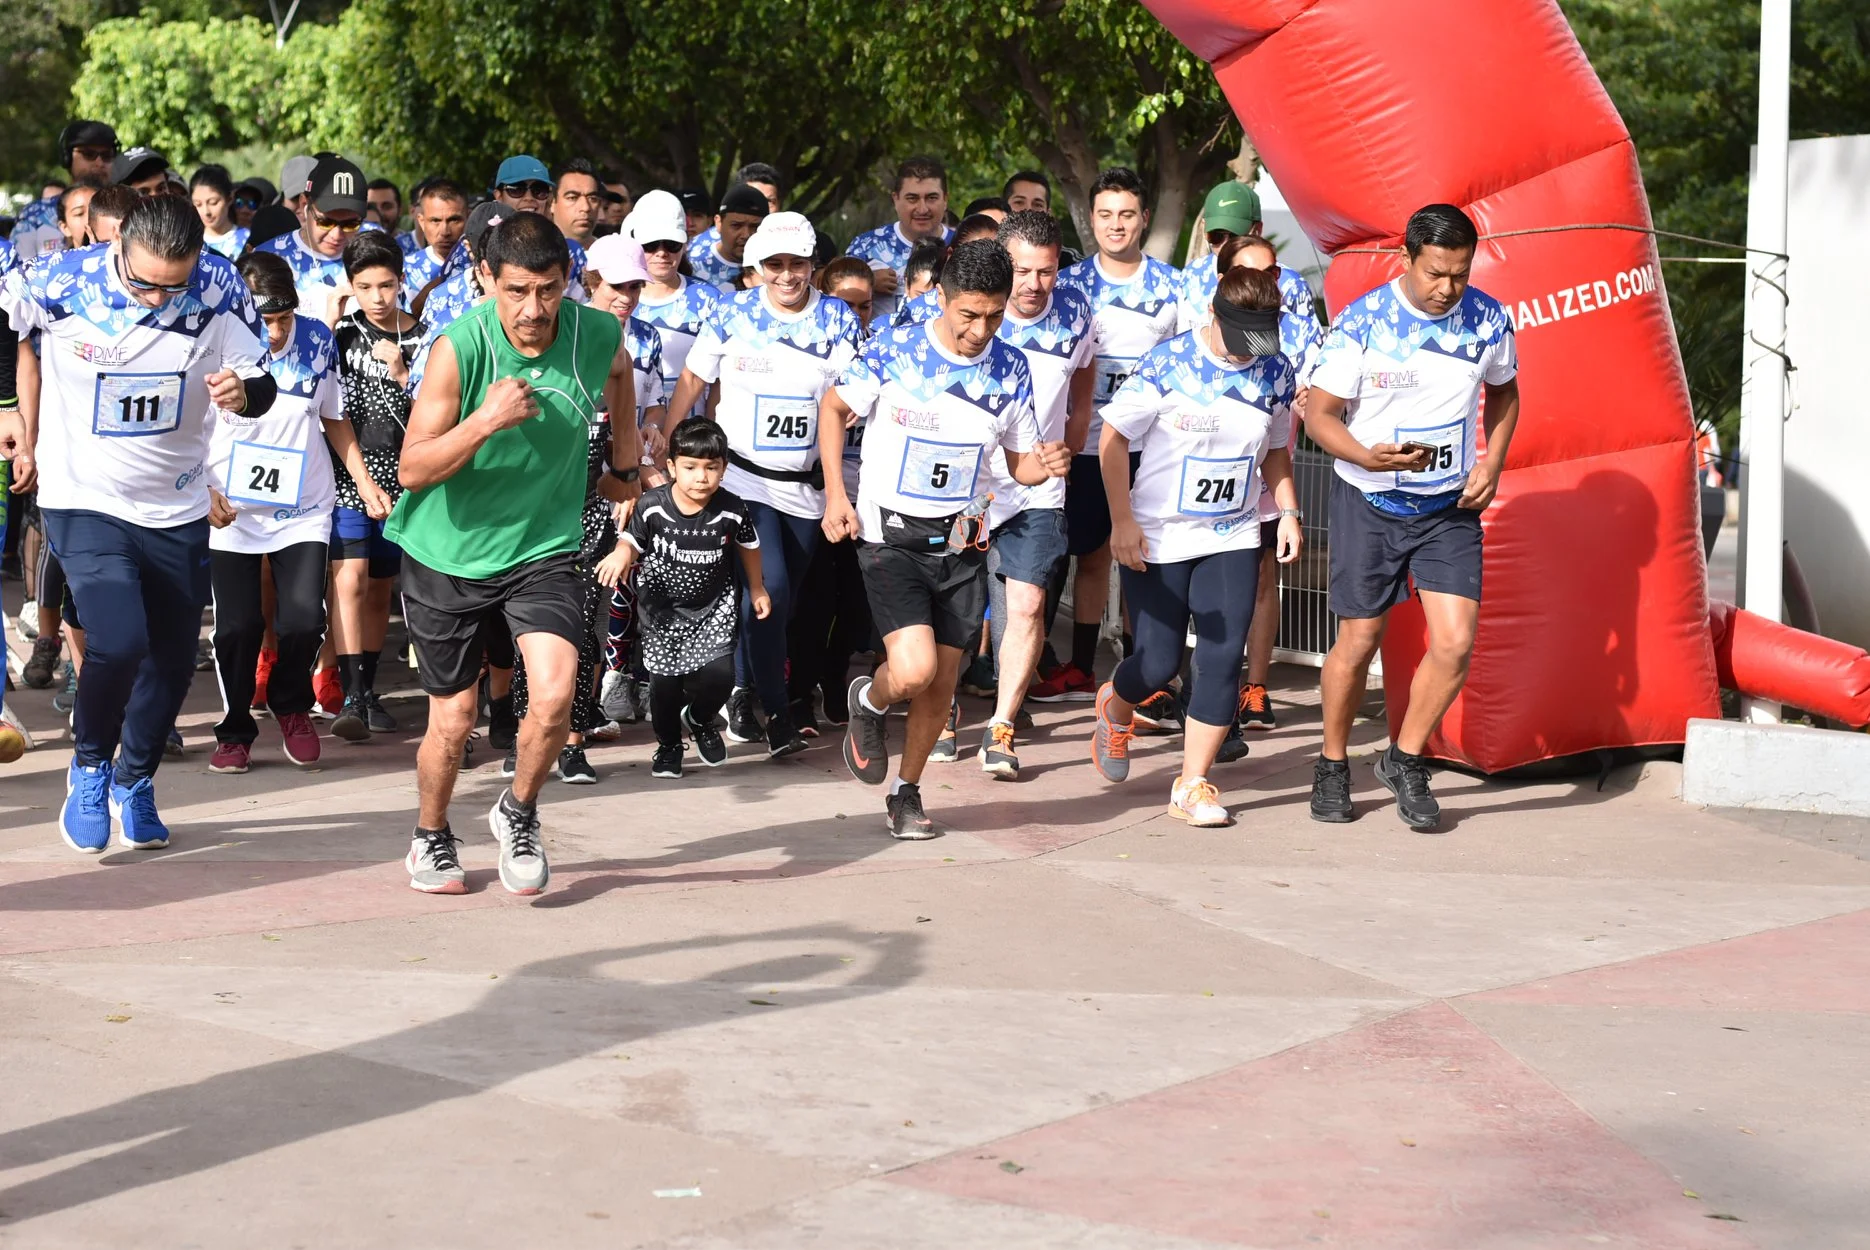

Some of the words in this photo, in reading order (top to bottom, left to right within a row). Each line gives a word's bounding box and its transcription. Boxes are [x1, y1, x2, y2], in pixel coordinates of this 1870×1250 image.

[93, 345, 129, 361] DIME
[1388, 370, 1419, 383] DIME
[118, 395, 160, 422] 111
[907, 410, 940, 427] DIME
[766, 414, 808, 439] 245
[1191, 415, 1220, 428] DIME
[1411, 444, 1453, 474] 75
[248, 465, 280, 493] 24
[930, 462, 950, 489] 5
[1195, 478, 1236, 504] 274
[676, 553, 723, 564] NAYARIT
